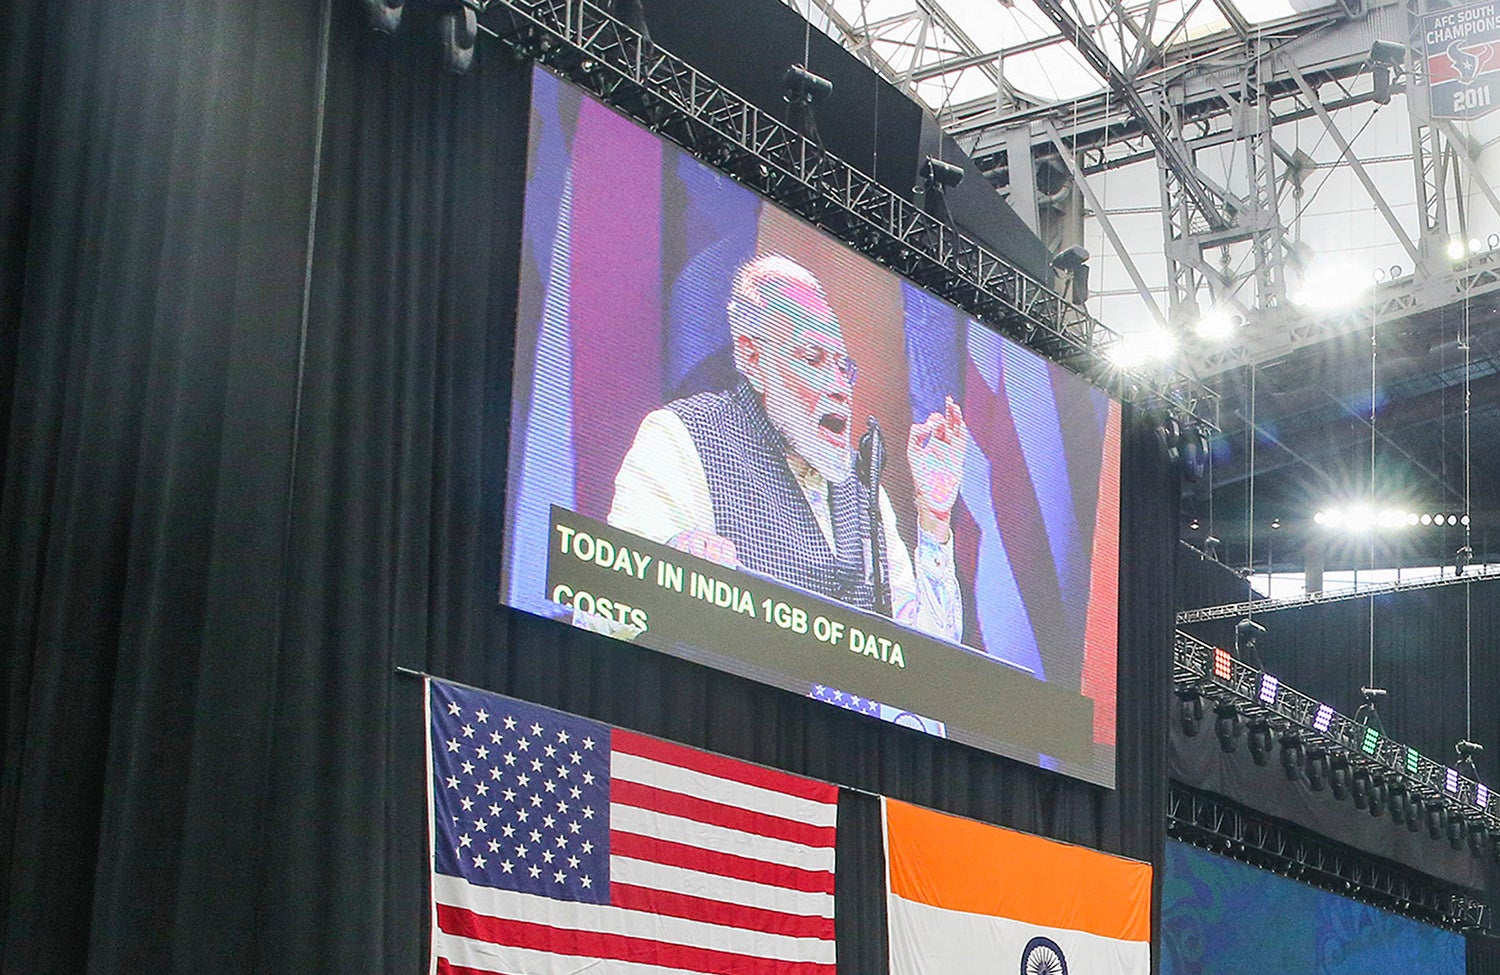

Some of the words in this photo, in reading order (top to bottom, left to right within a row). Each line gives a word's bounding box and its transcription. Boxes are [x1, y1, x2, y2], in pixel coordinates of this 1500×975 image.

[1434, 14, 1456, 29] AFC
[1457, 5, 1495, 23] SOUTH
[1453, 85, 1491, 113] 2011
[552, 584, 649, 632] COSTS
[556, 524, 652, 580] TODAY
[656, 560, 684, 593] IN
[689, 571, 757, 618] INDIA
[761, 598, 810, 635] 1GB
[813, 616, 845, 646] OF
[849, 627, 906, 669] DATA
